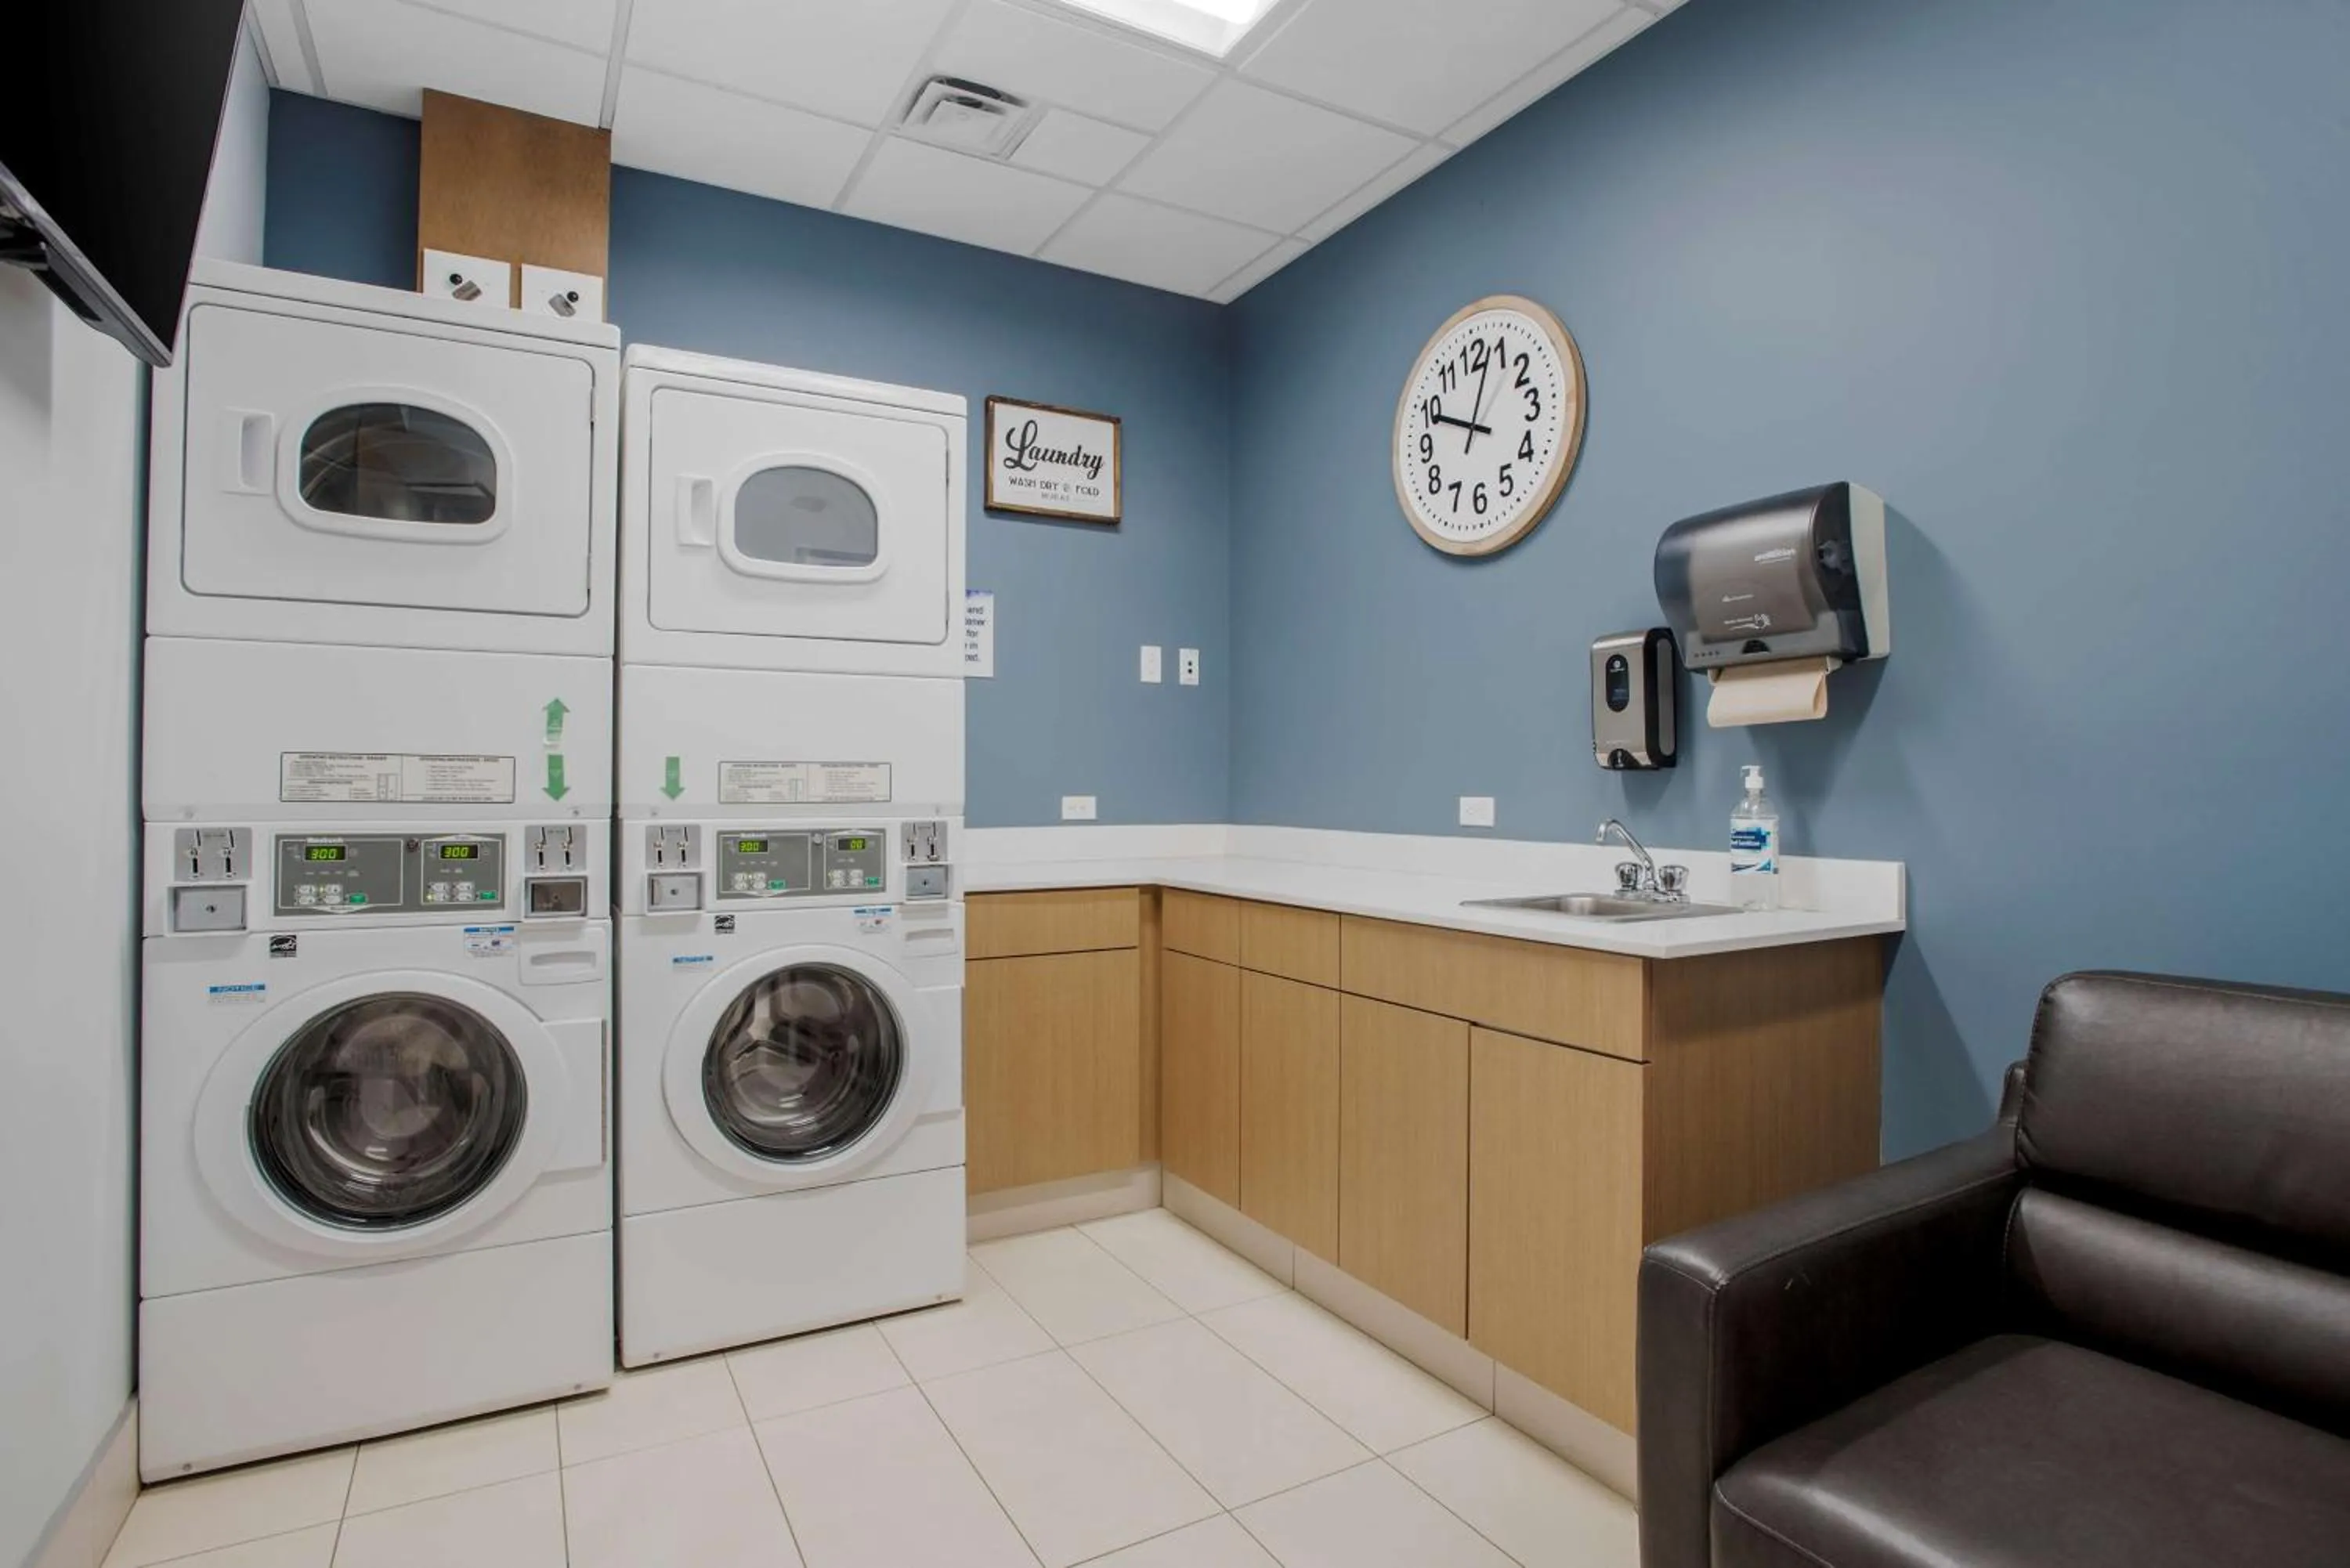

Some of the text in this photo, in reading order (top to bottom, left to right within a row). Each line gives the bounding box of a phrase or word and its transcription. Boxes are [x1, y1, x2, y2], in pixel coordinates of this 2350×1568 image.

[1459, 338, 1487, 377] 12
[1494, 335, 1506, 369] 1
[1438, 359, 1457, 393] 11
[1513, 352, 1531, 388] 2
[1420, 395, 1441, 428] 10
[1524, 387, 1541, 421] 3
[1003, 419, 1103, 480] Laundry
[1419, 433, 1433, 464] 9
[1517, 429, 1534, 463] 4
[1009, 476, 1036, 488] WASH
[1039, 480, 1059, 490] DRY
[1076, 485, 1099, 496] FOLD
[1428, 464, 1441, 494] 8
[1499, 463, 1514, 497] 5
[1448, 480, 1462, 513] 7
[1473, 482, 1488, 514] 6
